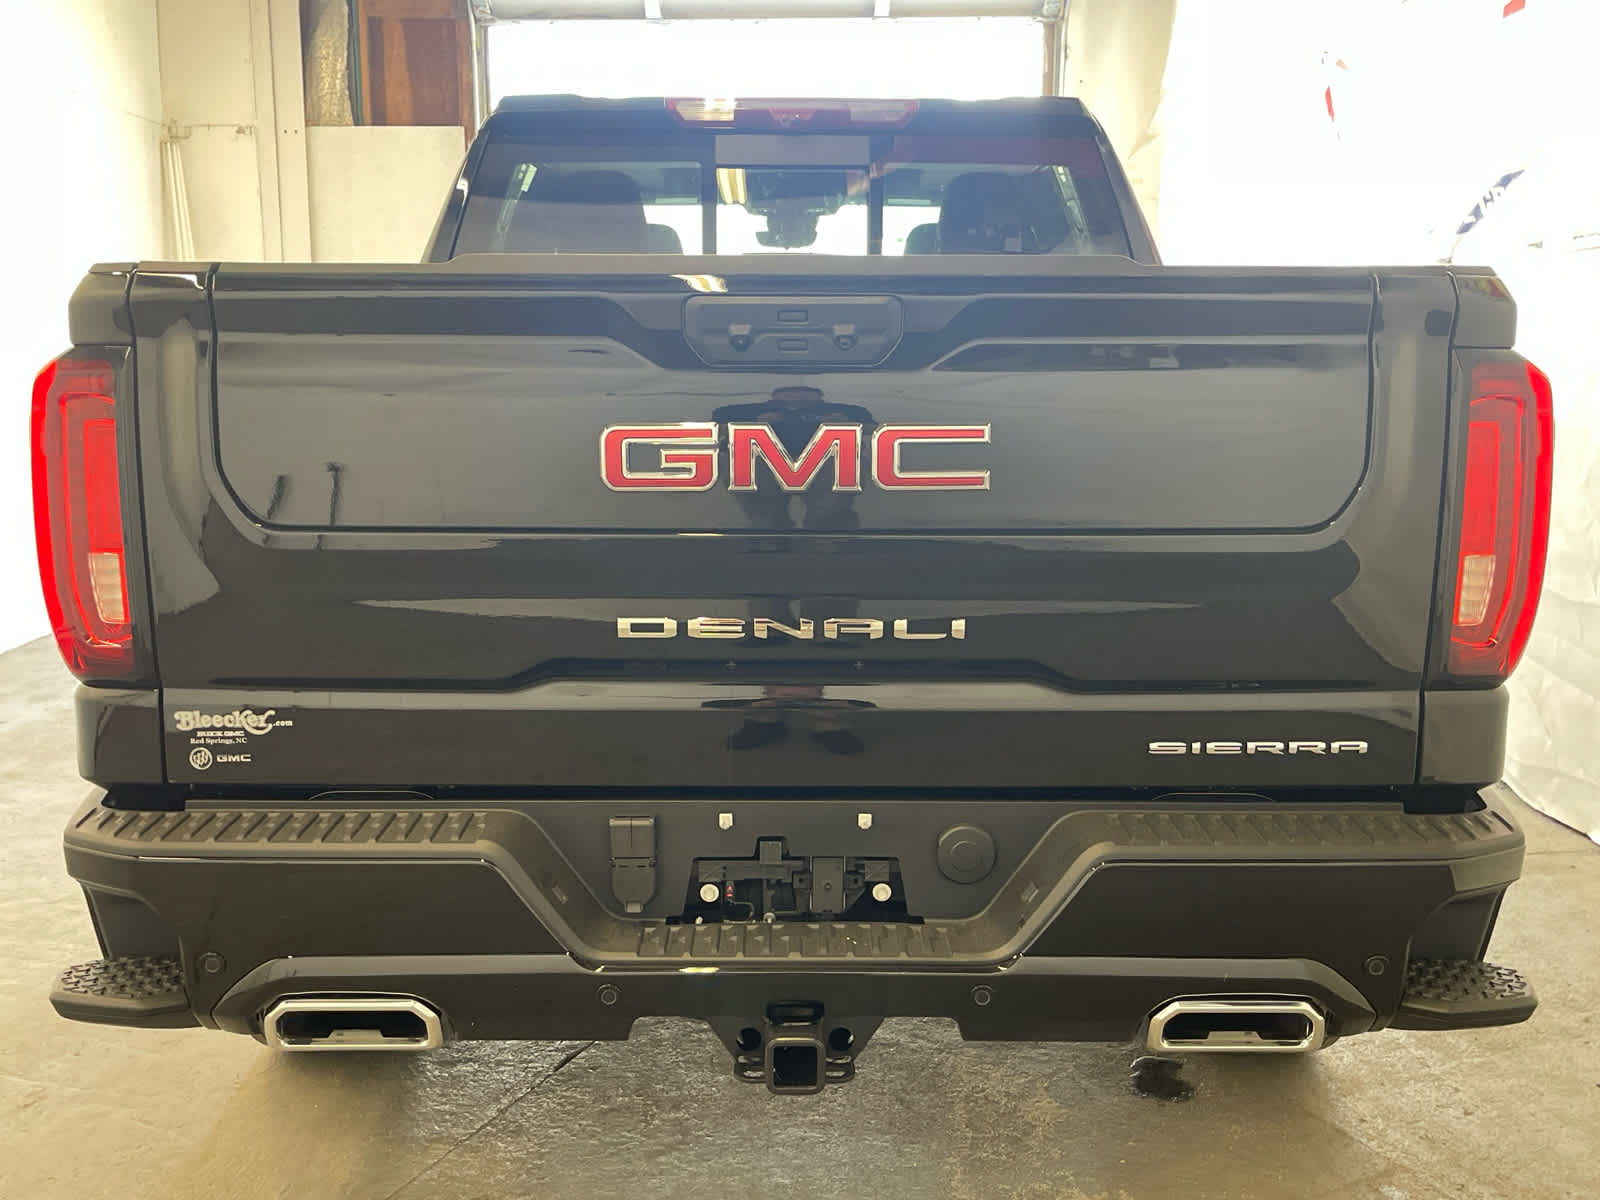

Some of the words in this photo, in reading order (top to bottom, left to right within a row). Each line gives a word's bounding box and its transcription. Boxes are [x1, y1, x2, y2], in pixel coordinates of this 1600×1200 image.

[600, 422, 991, 492] GMC
[617, 616, 966, 640] DENALI
[1148, 740, 1368, 755] SIERRA
[216, 753, 252, 762] GMC
